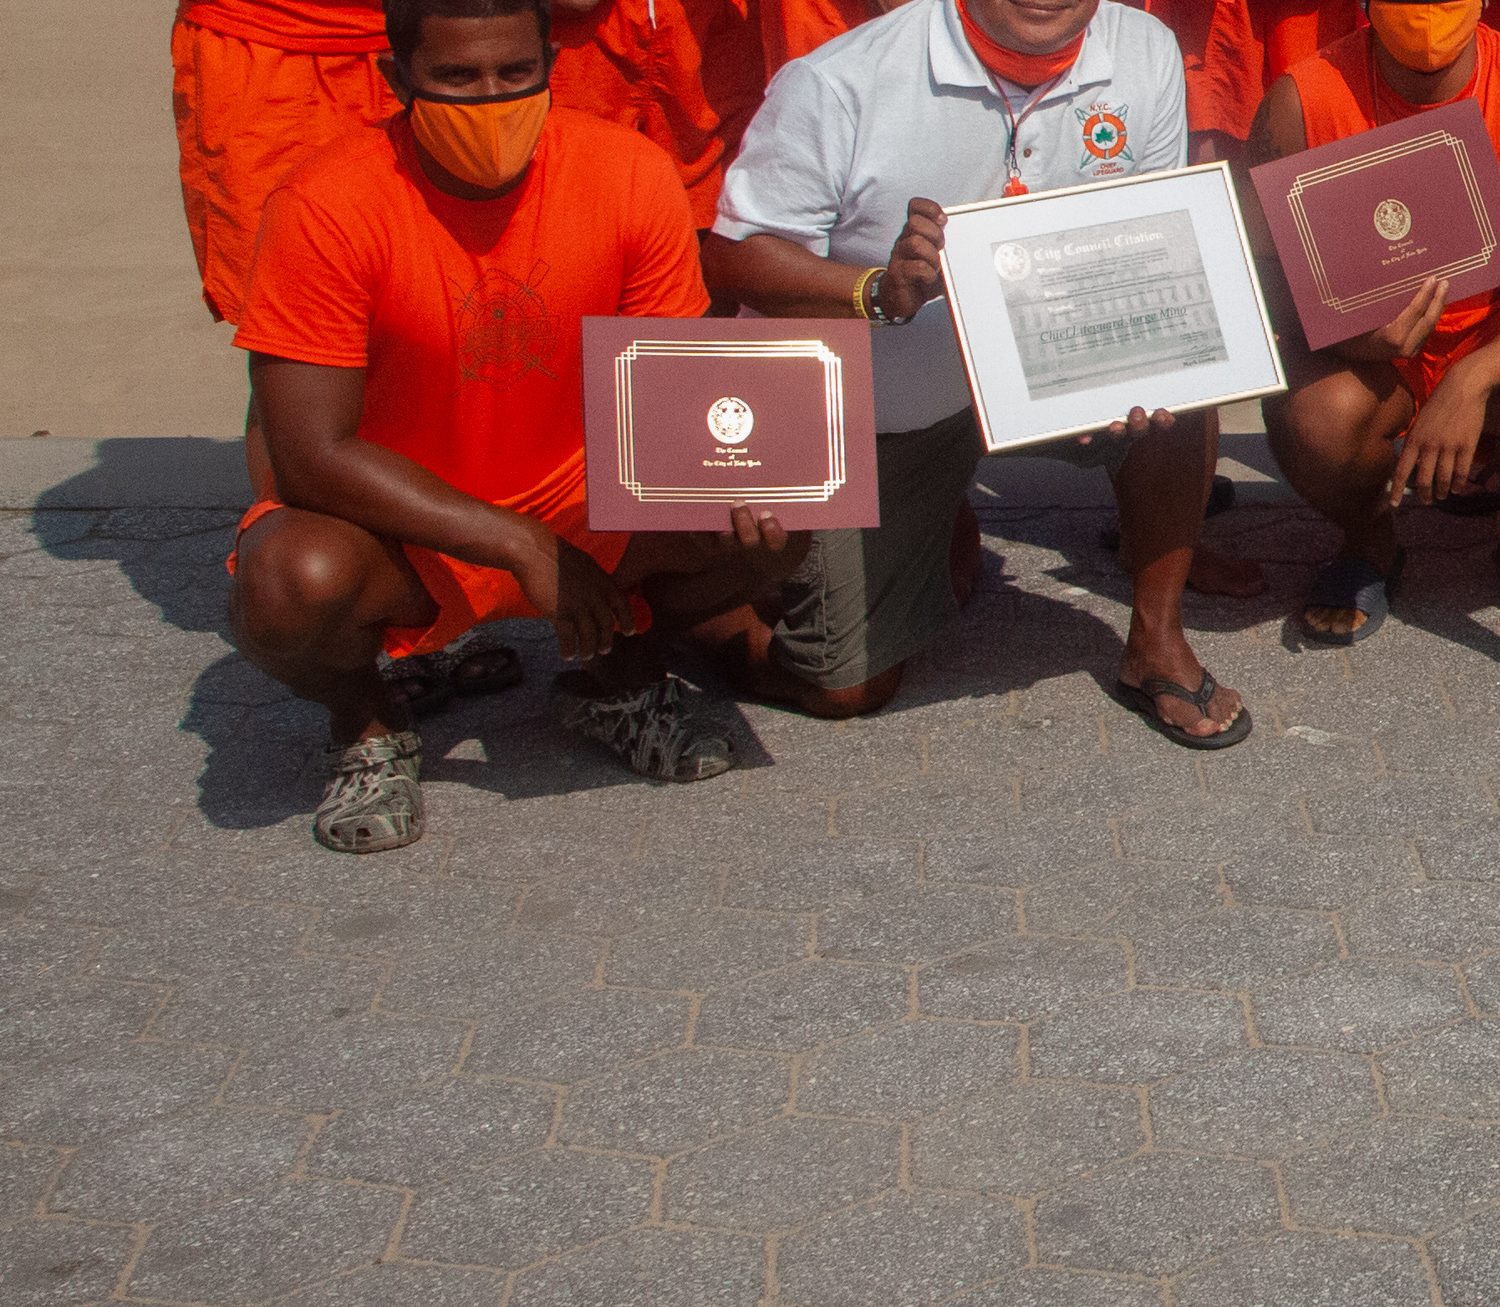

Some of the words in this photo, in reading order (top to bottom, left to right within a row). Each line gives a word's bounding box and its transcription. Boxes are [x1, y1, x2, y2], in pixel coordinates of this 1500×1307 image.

[1089, 103, 1112, 112] N.Y.C.
[1099, 162, 1117, 171] CHIEF
[1092, 167, 1125, 177] LIFEGUARD
[1034, 247, 1062, 263] City
[1064, 238, 1112, 256] Council
[1114, 231, 1165, 247] Citation
[1040, 329, 1072, 345] Chief
[1126, 313, 1157, 331] Jorge
[1160, 305, 1187, 319] Mino
